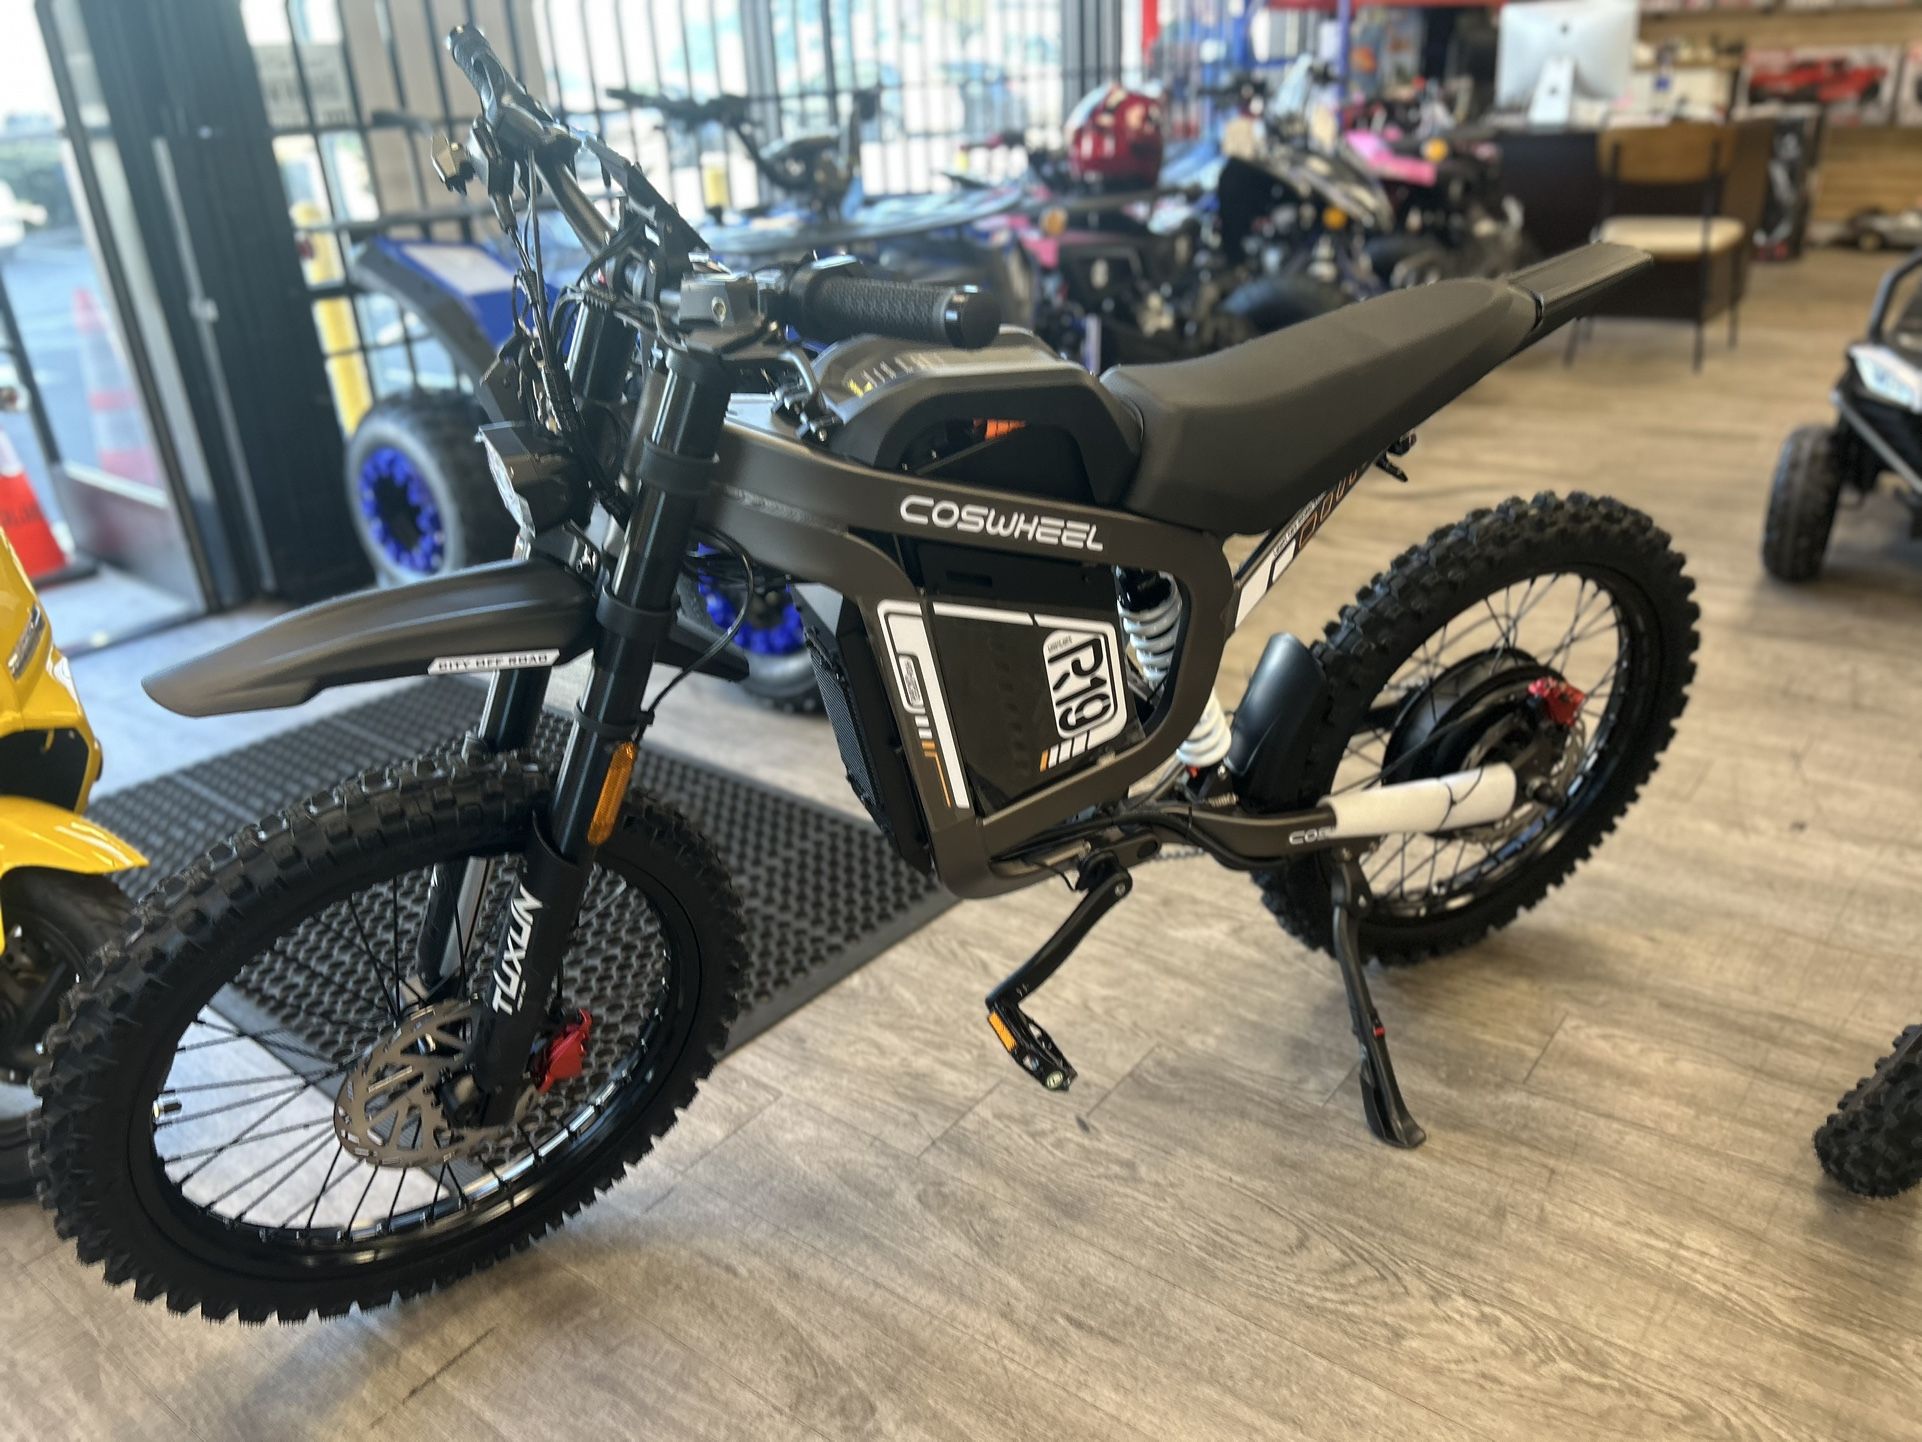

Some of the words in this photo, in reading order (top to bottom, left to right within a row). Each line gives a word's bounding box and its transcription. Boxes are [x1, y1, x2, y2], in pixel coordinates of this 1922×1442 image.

[900, 495, 1103, 552] COSWHEEL
[1048, 638, 1112, 731] R19
[492, 883, 544, 1016] TUXUN
